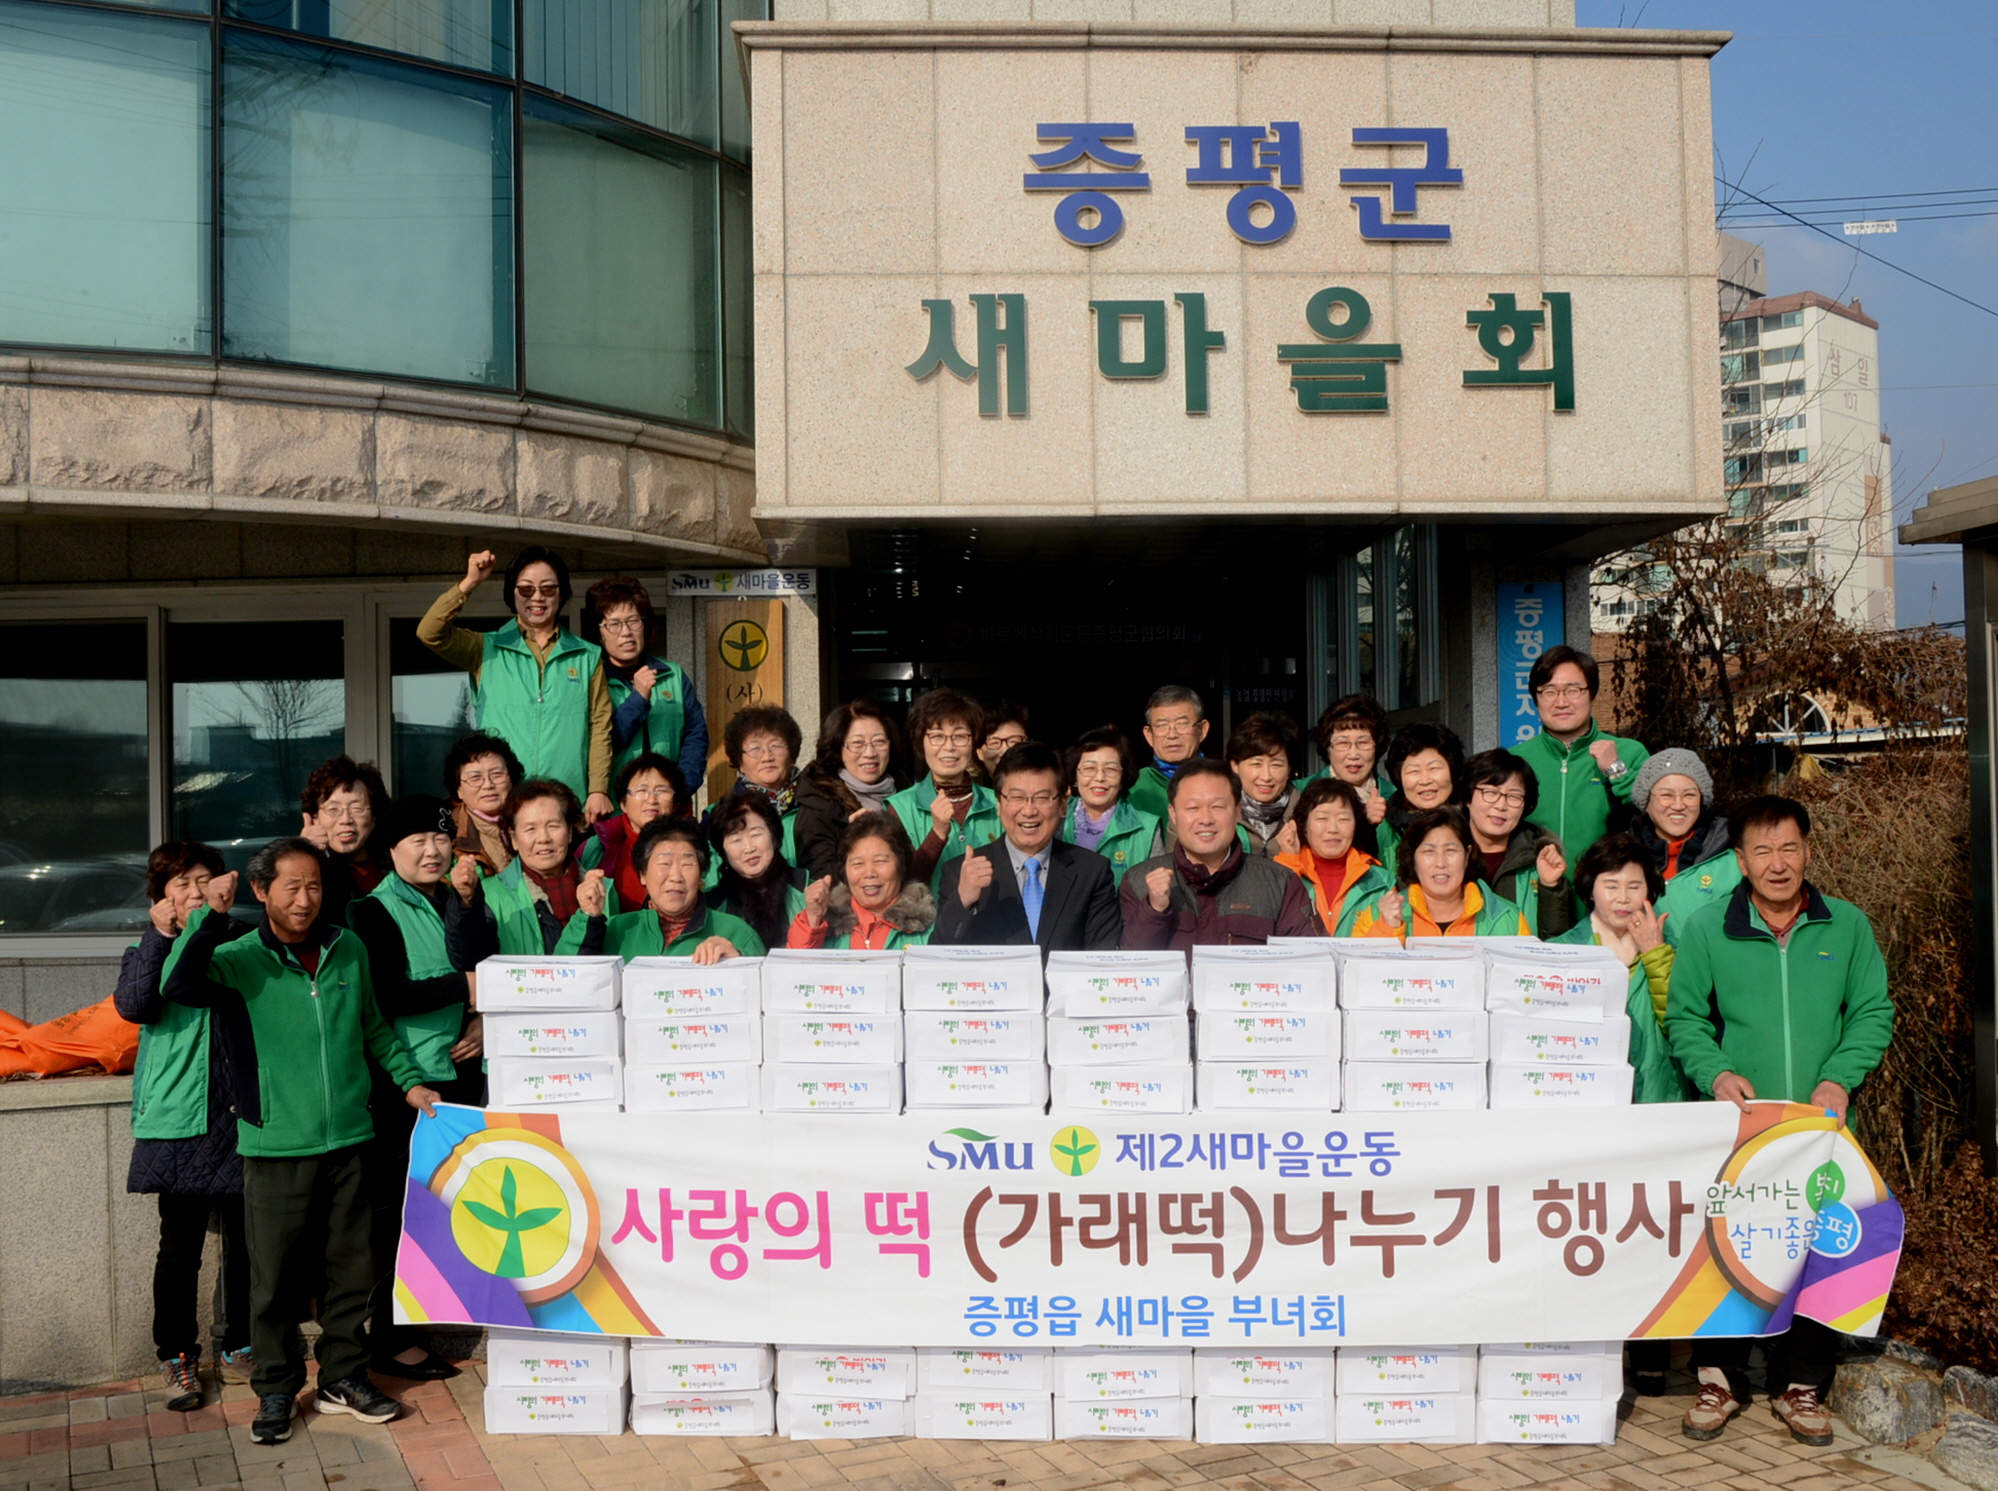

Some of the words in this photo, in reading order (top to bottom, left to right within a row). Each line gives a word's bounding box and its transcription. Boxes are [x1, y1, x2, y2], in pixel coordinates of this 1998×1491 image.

[1024, 121, 1463, 246] 증평군
[904, 286, 1576, 416] 새마을회
[737, 573, 812, 590] 새마을운동
[726, 682, 763, 704] (사)
[928, 1138, 1033, 1171] SMU
[1116, 1131, 1401, 1178] 제2새마을운동
[1706, 1179, 1800, 1214] 앞서가는
[611, 1187, 832, 1282] 사랑의
[864, 1191, 931, 1279] 떡
[963, 1185, 1502, 1284] (가래떡)나누기
[1533, 1179, 1696, 1277] 행사
[964, 1295, 1082, 1338] 증평읍
[1095, 1295, 1215, 1338] 새마을
[1228, 1295, 1346, 1337] 부녀회
